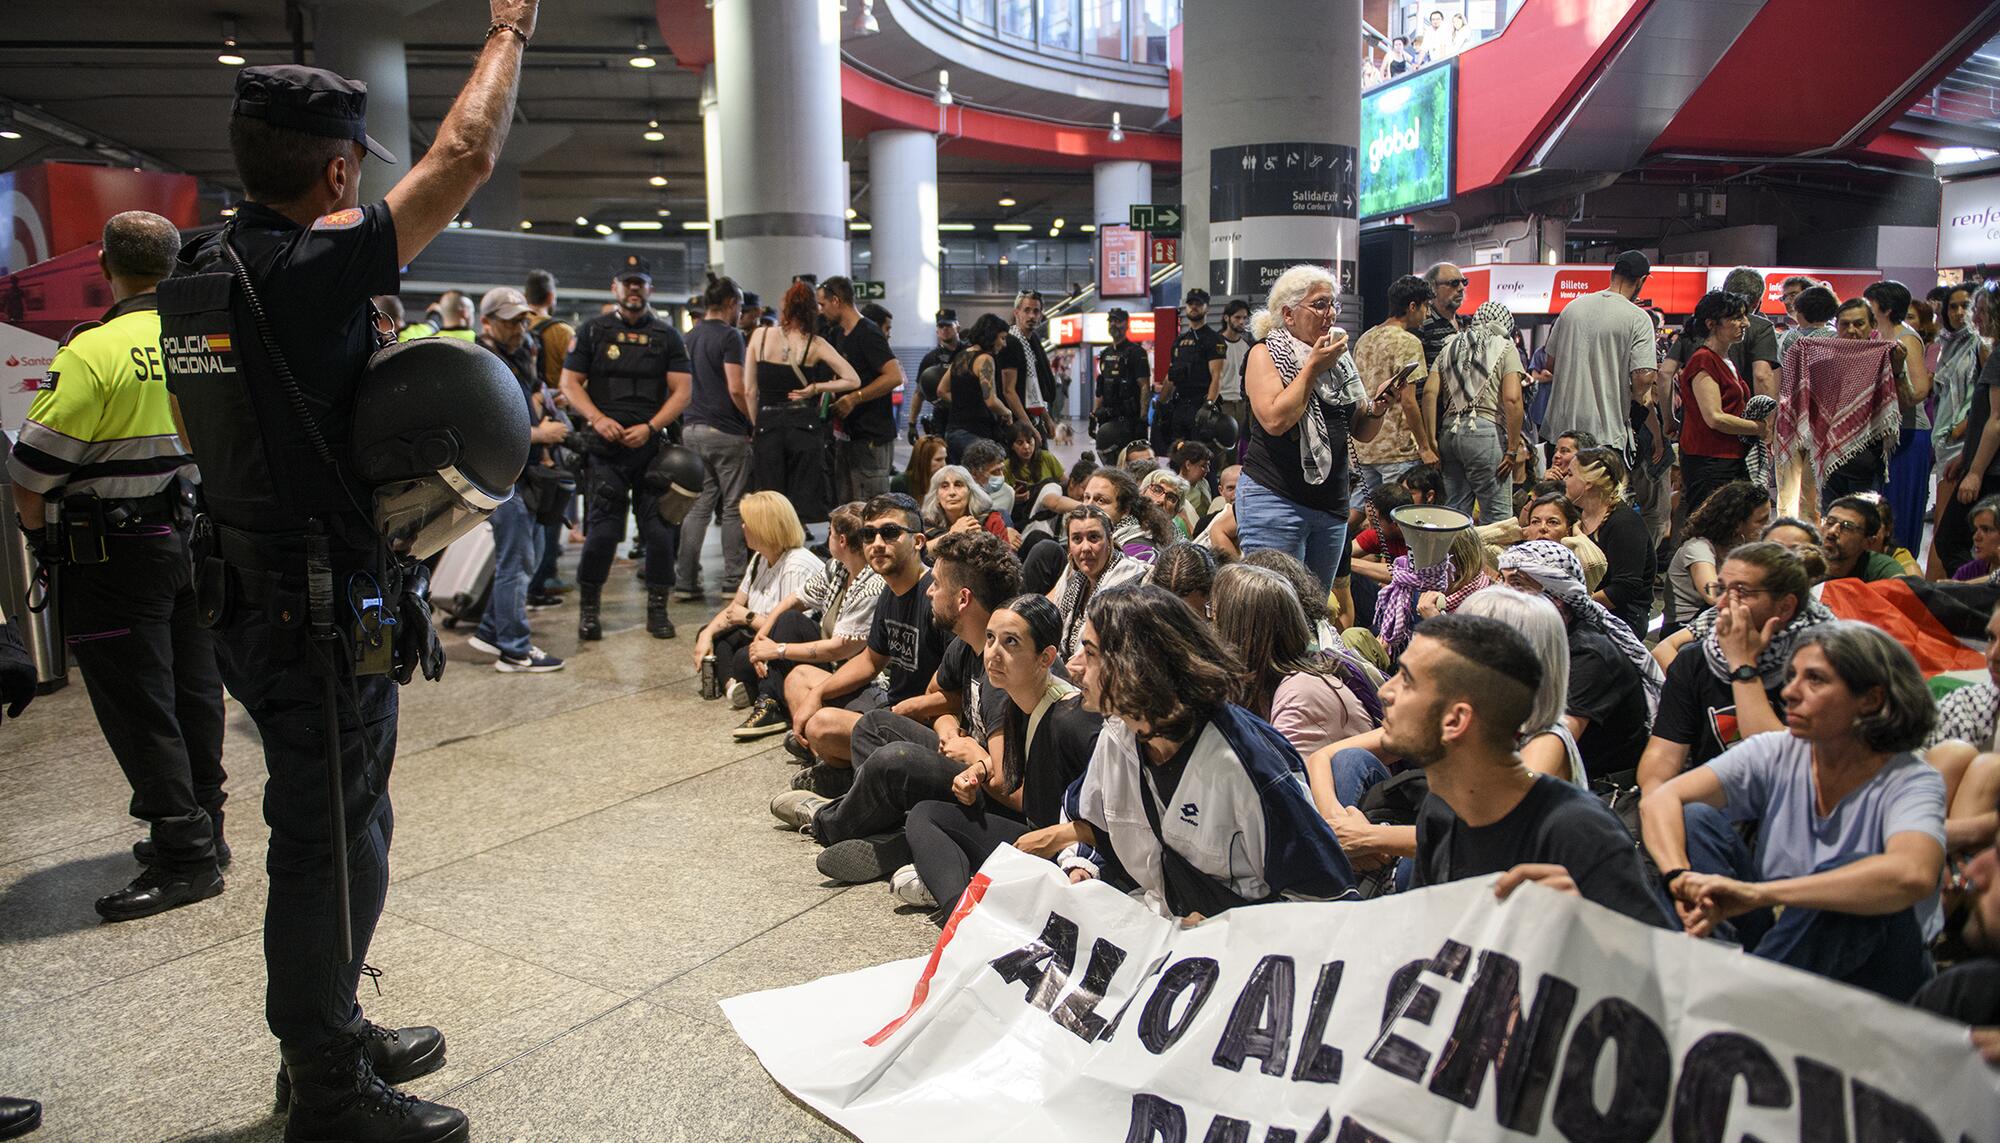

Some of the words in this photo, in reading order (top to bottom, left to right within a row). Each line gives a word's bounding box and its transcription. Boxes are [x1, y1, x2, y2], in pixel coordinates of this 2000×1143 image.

[1369, 116, 1420, 174] global
[1292, 190, 1338, 203] Salida/Exit
[1306, 203, 1326, 211] Carlos
[1951, 207, 2000, 228] renfe
[1496, 281, 1525, 292] renfe
[1560, 280, 1589, 290] Billetes
[21, 356, 53, 366] Santa
[131, 347, 163, 382] SE
[1212, 954, 1344, 1085] AL
